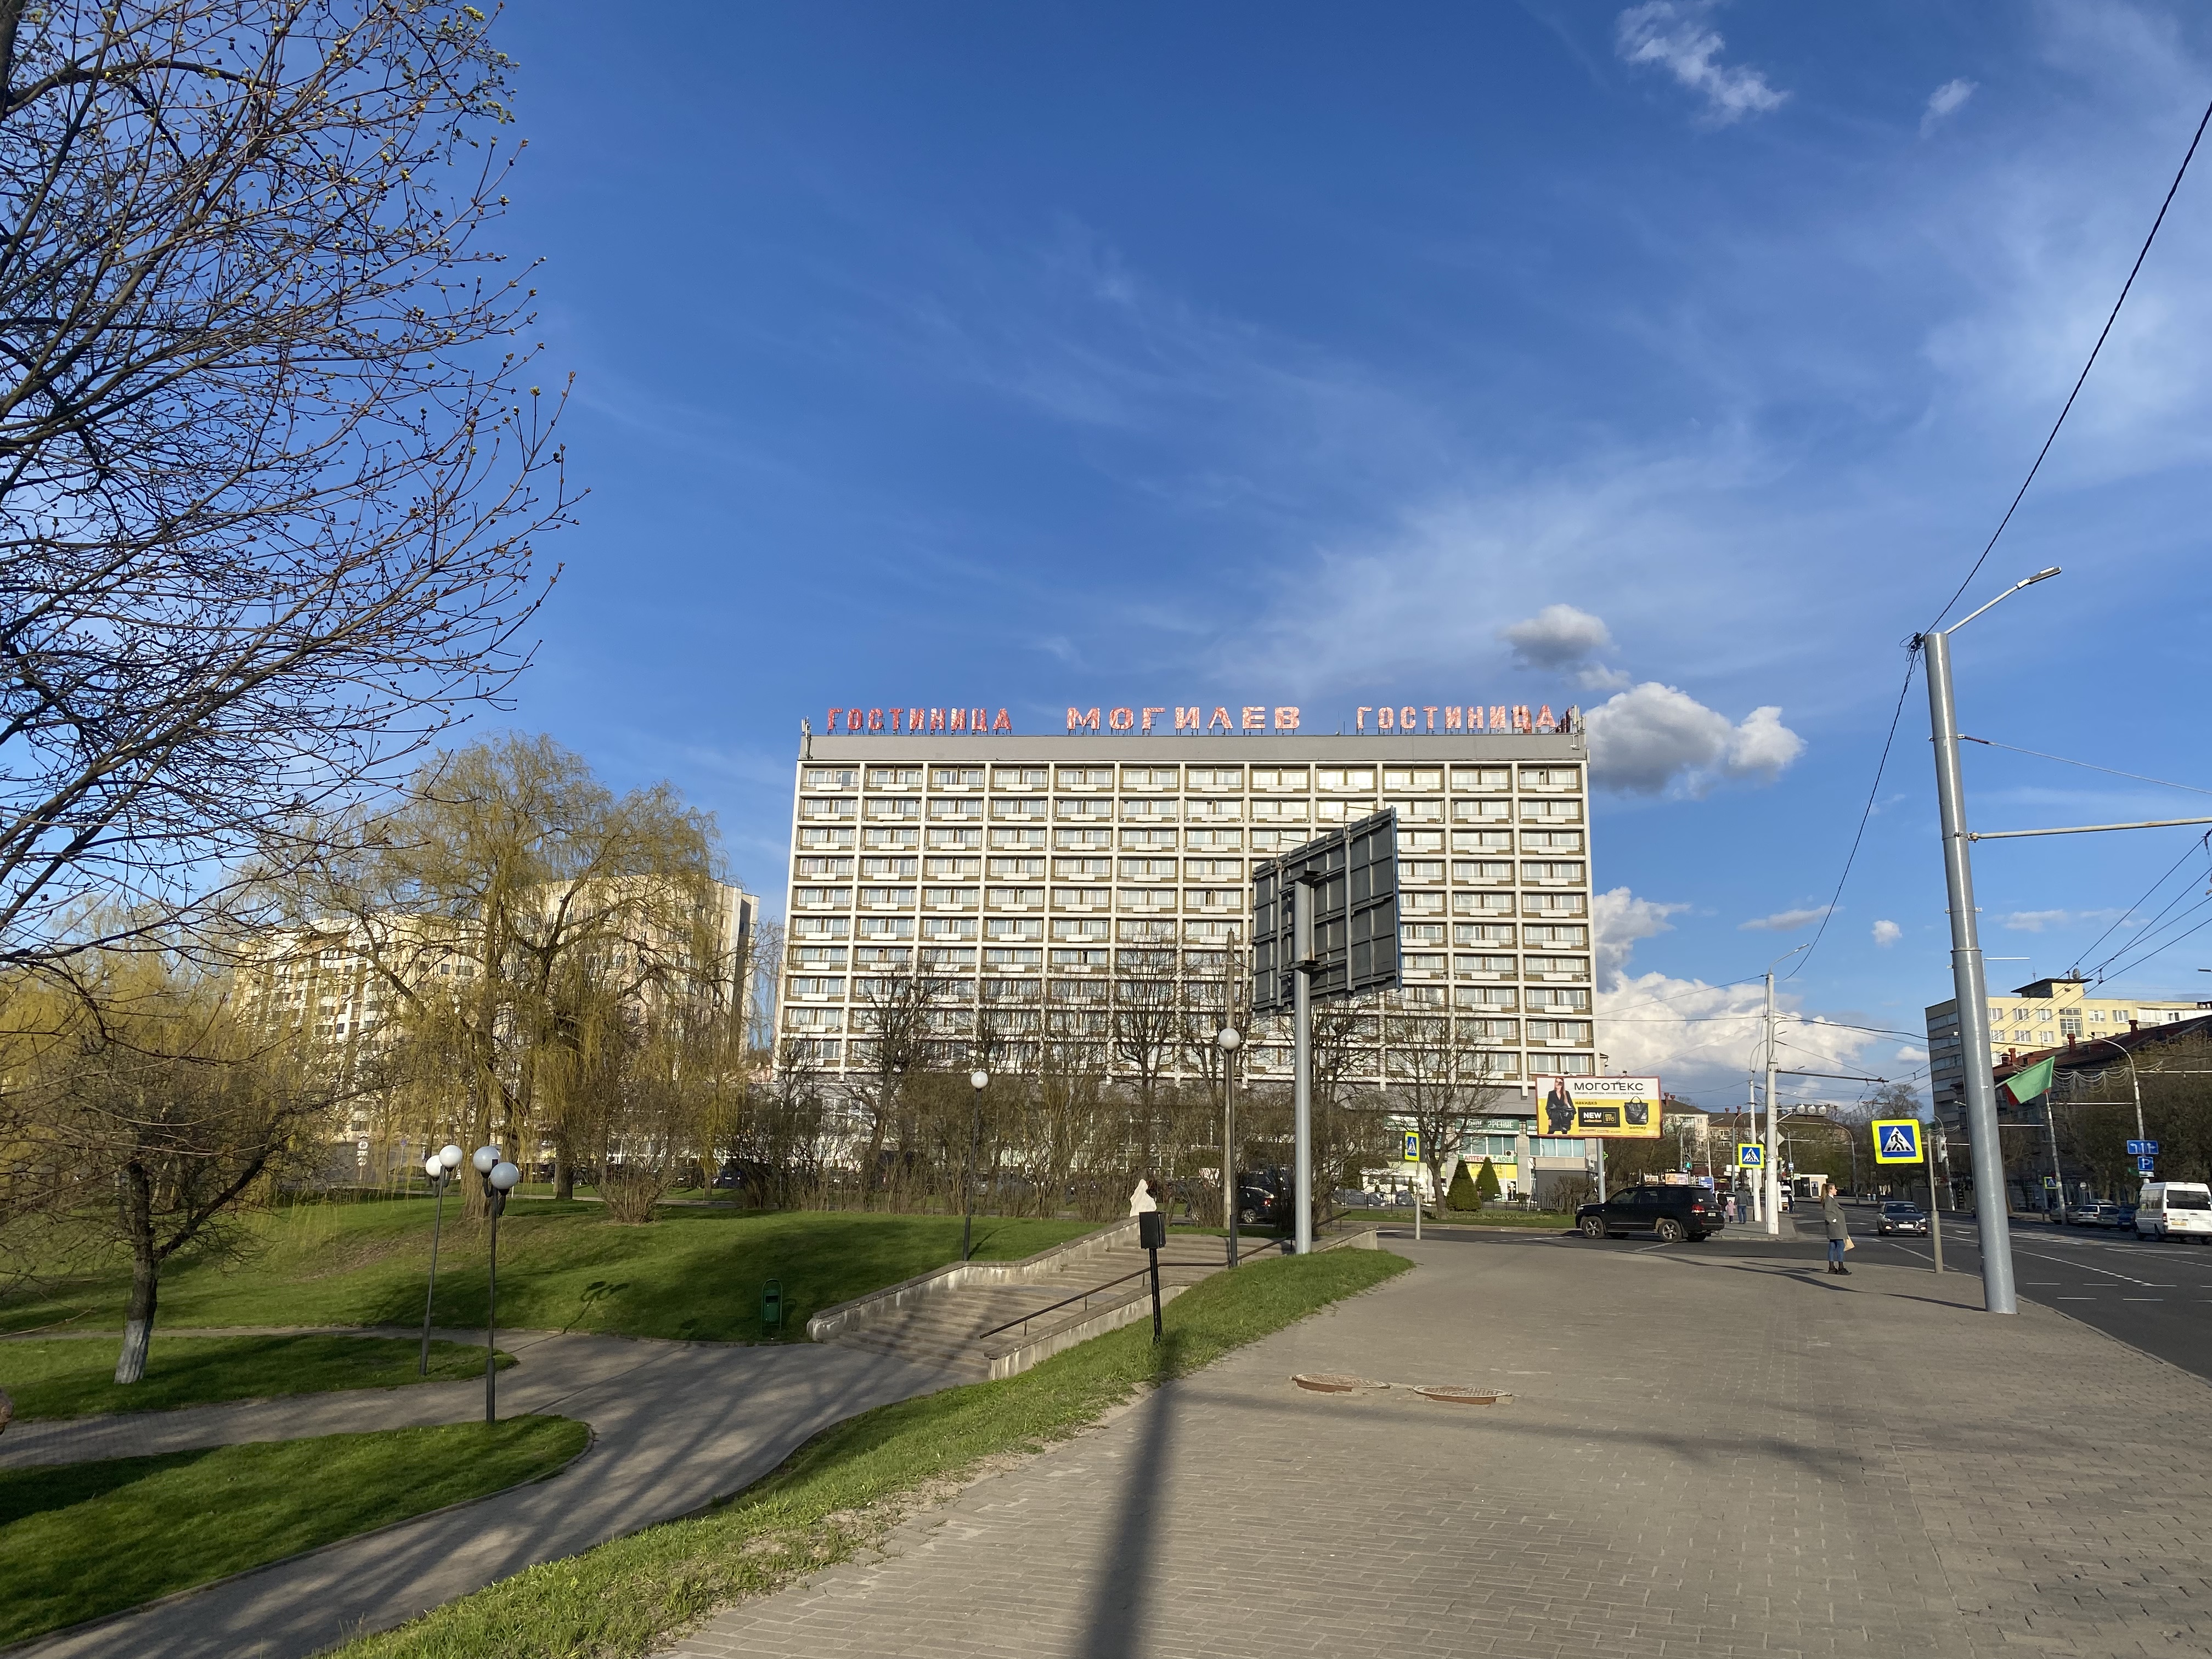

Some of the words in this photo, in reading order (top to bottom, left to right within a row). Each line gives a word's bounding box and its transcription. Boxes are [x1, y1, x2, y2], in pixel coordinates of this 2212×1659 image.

[828, 708, 1013, 732] ГОСТИНИЦА
[1066, 706, 1300, 730] МОГИЛЕВ
[1356, 704, 1556, 730] ГОСТИНИЦА
[1574, 1082, 1644, 1091] МОГОТЕКС
[2142, 1158, 2150, 1169] P
